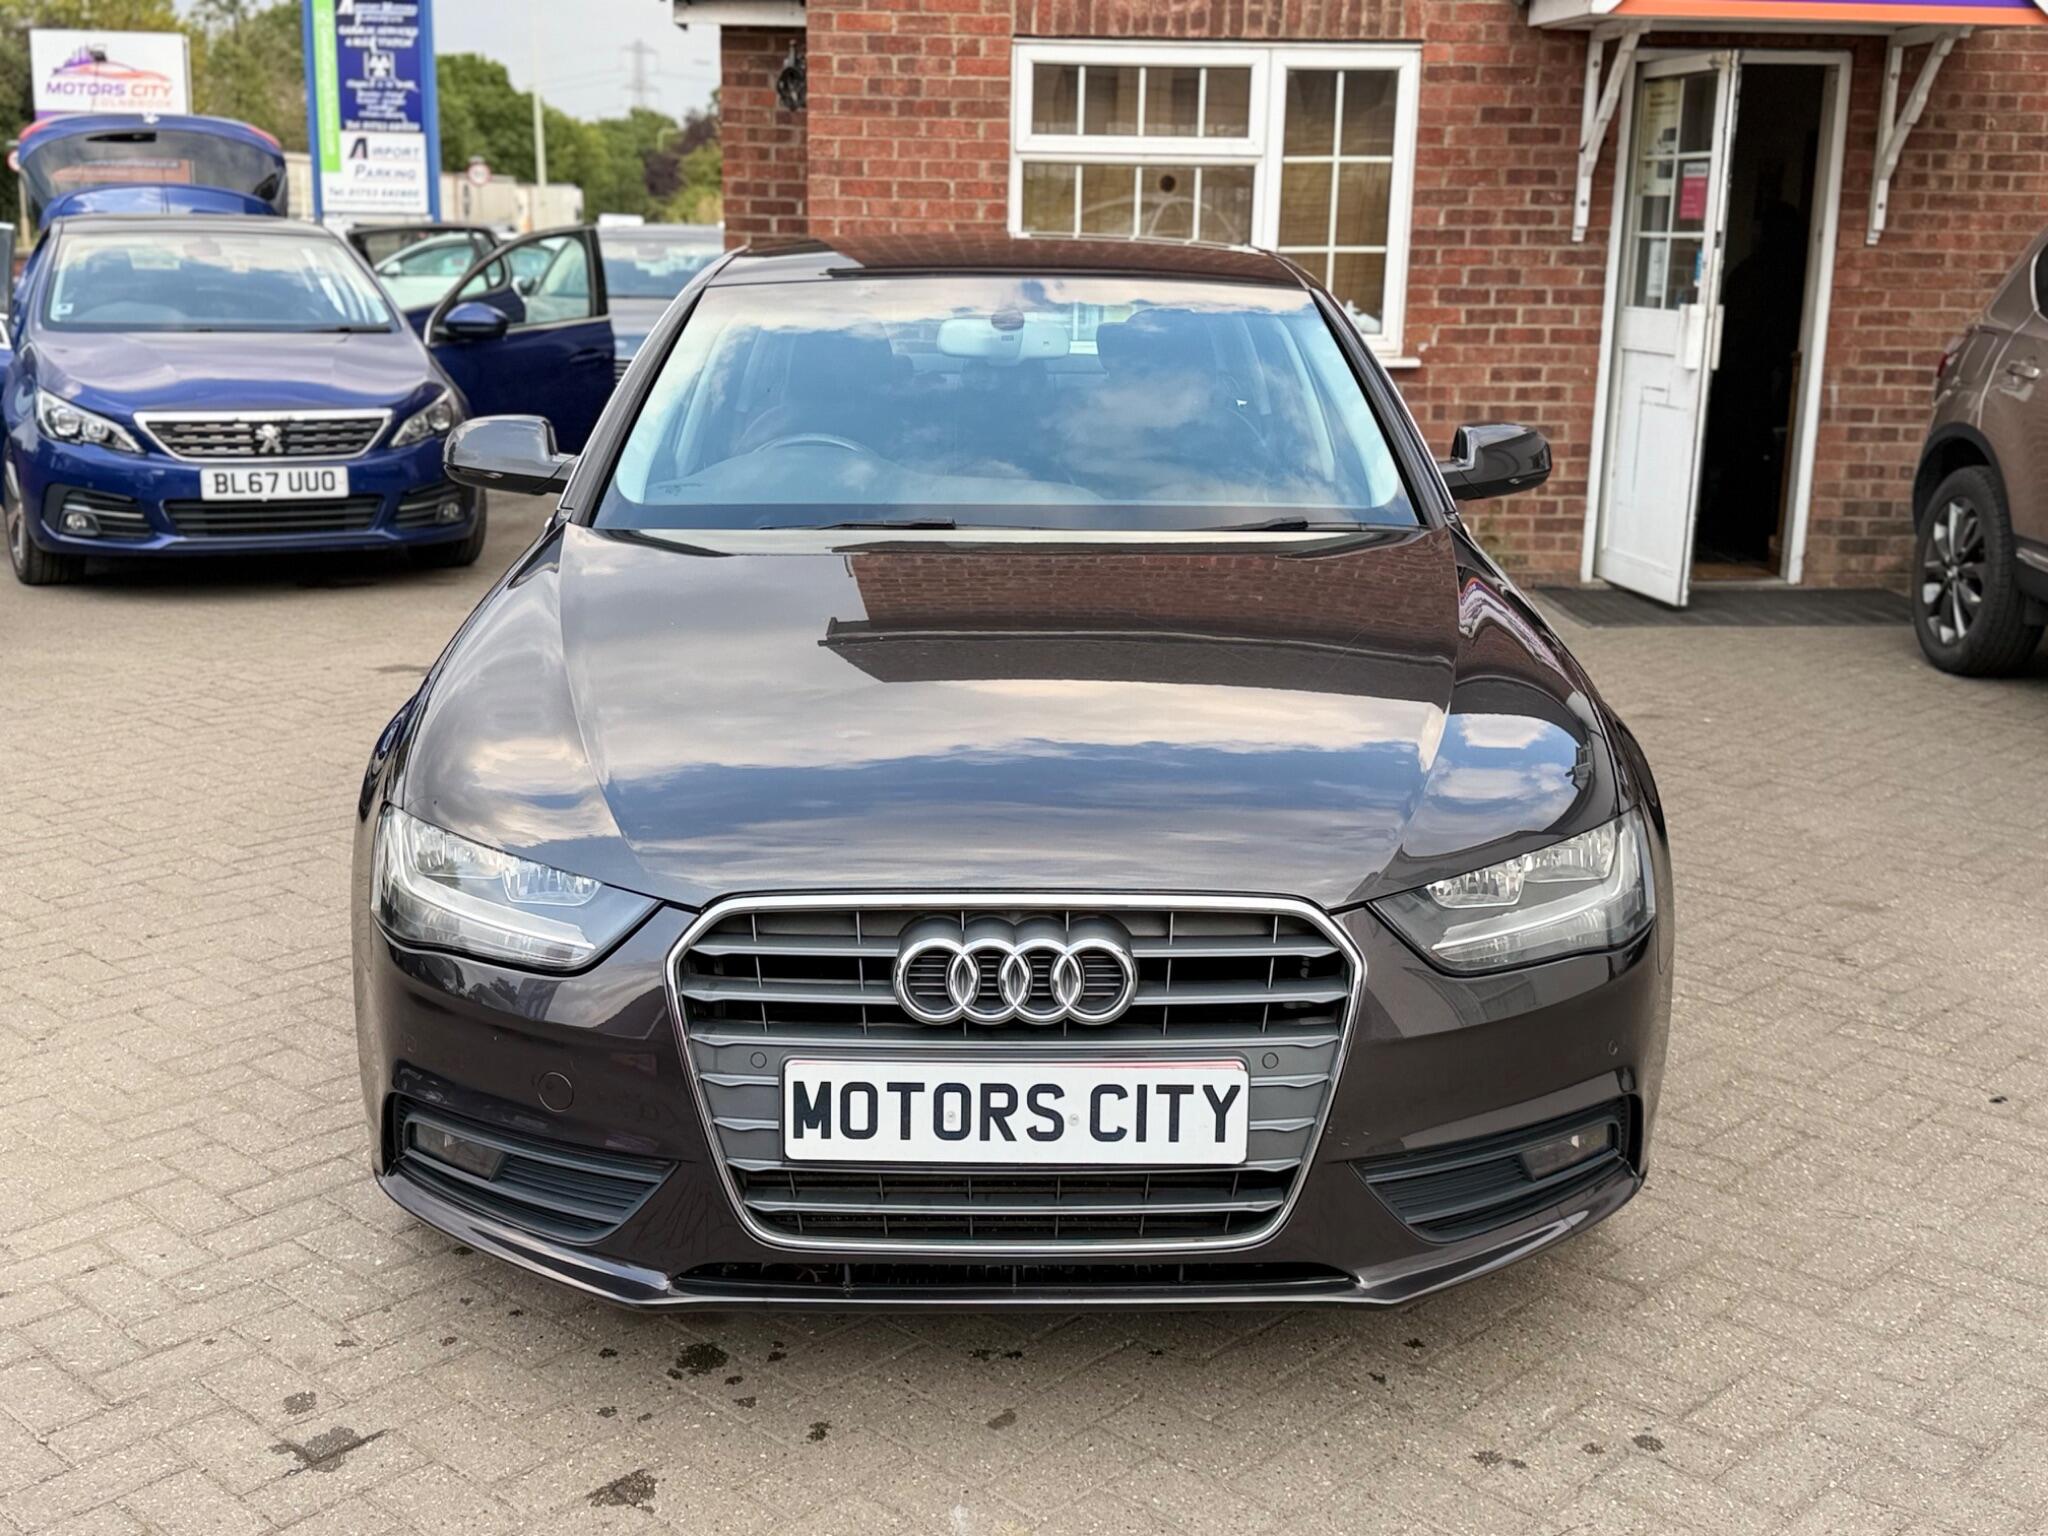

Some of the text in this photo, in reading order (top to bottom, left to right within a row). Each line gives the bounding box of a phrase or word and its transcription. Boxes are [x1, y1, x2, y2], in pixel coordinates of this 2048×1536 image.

[46, 81, 173, 97] MOTORS CITY
[349, 136, 420, 160] AIRPORT
[213, 471, 336, 494] BL67 UUO
[792, 1081, 1242, 1144] MOTORS CITY
